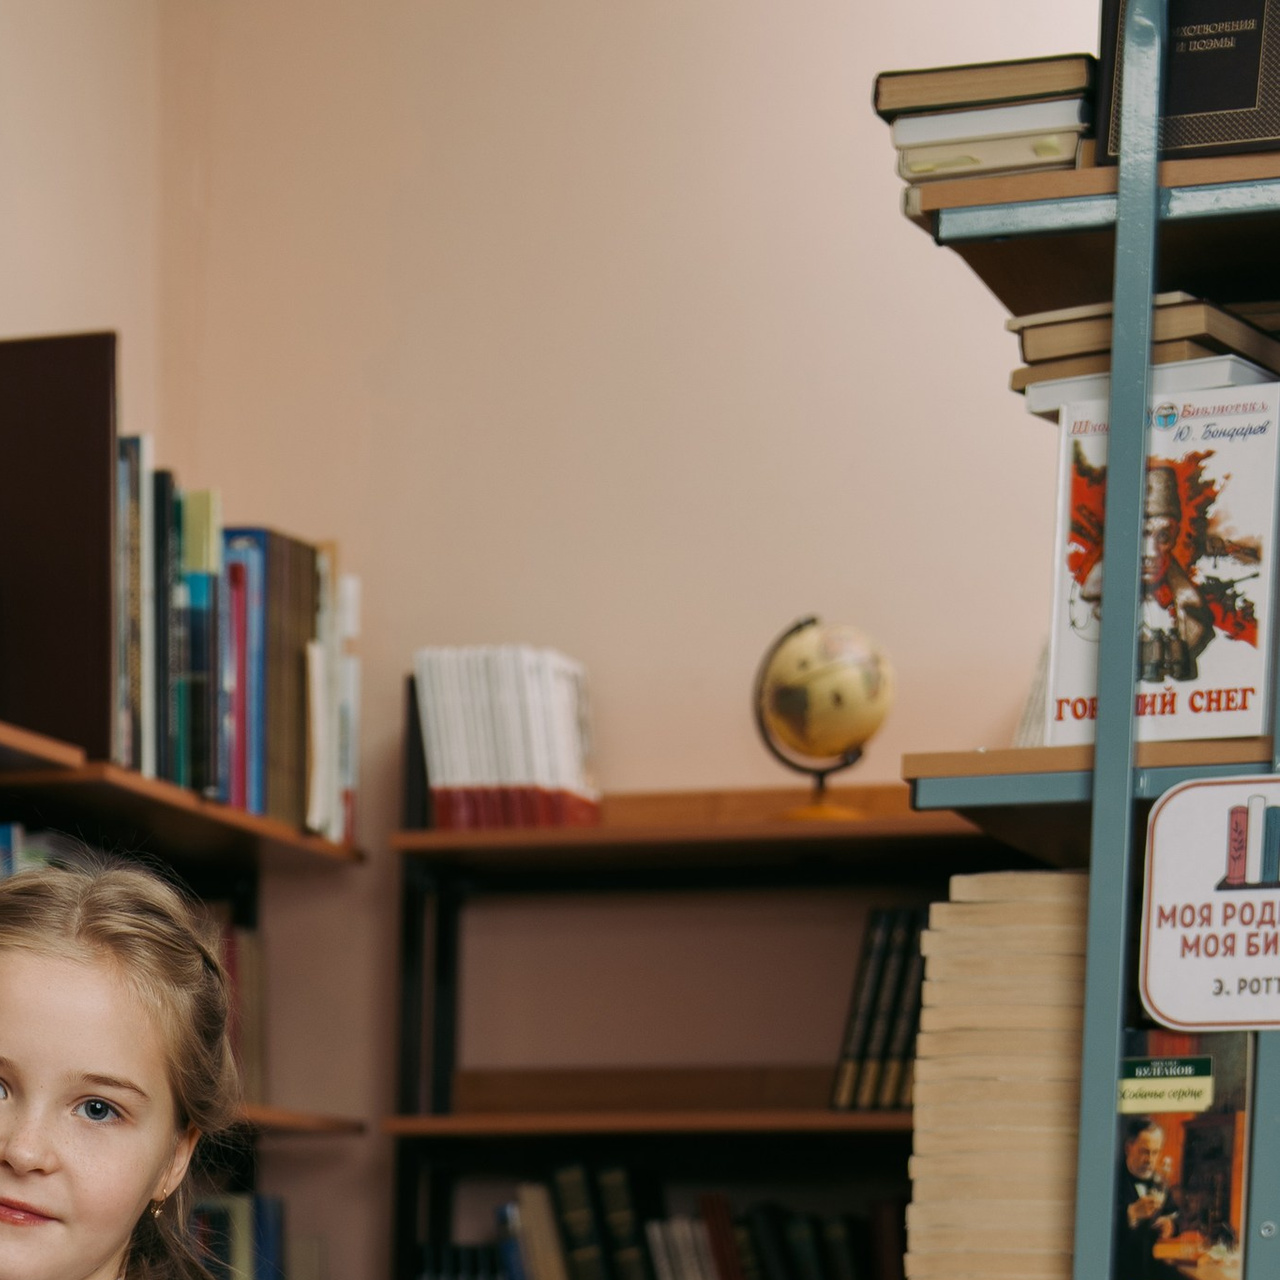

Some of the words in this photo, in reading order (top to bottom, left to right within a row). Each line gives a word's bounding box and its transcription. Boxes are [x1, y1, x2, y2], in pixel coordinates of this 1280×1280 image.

[1177, 19, 1256, 37] ХОТВОРЕНИЯ
[1188, 36, 1236, 52] ПОЭМЫ
[1201, 420, 1270, 443] Бондарев
[1188, 686, 1255, 713] СНЕГ
[1158, 903, 1213, 929] МОЯ
[1223, 901, 1280, 928] РОД
[1181, 932, 1236, 958] МОЯ
[1246, 931, 1280, 957] БИ
[1213, 978, 1231, 996] Э.
[1237, 976, 1280, 995] РОТТ
